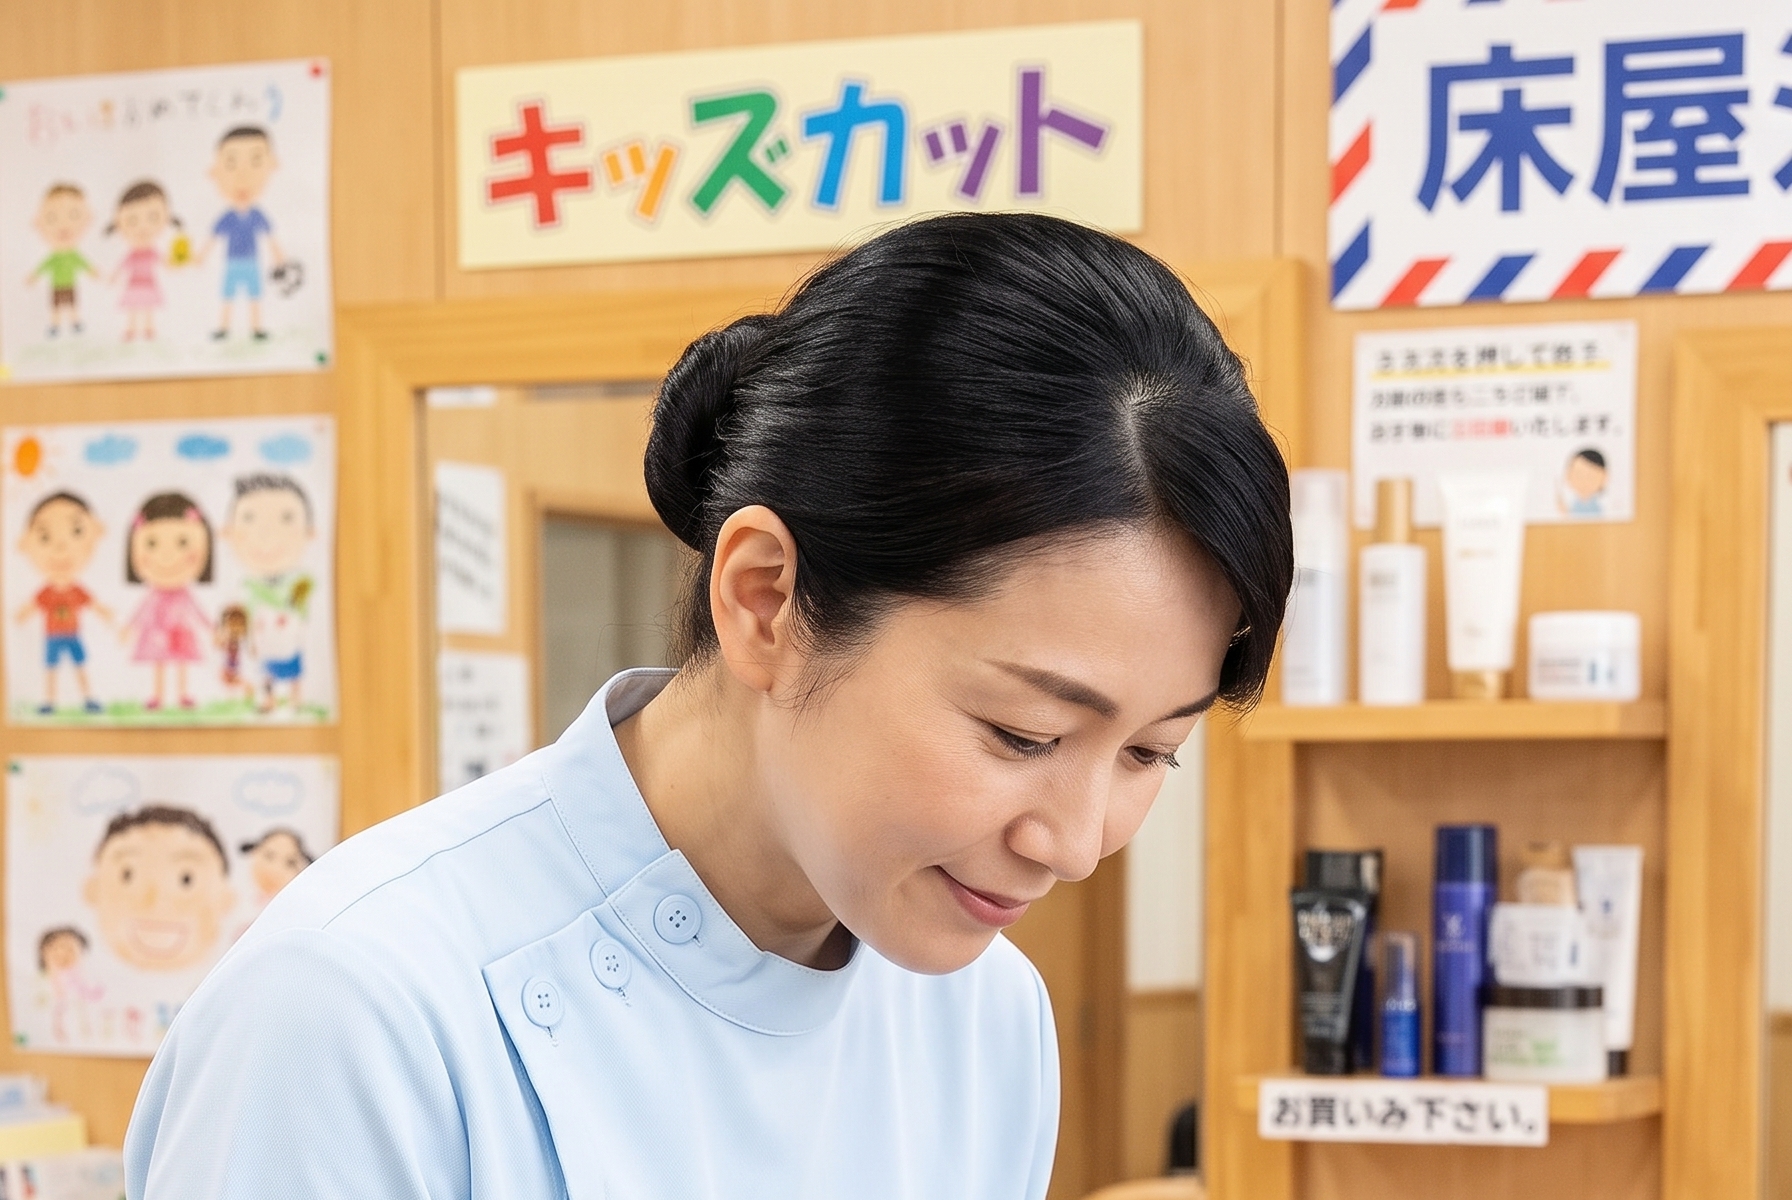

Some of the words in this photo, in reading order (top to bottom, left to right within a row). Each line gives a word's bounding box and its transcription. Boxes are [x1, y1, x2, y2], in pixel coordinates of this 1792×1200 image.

[488, 66, 1108, 226] キッズカット
[1417, 31, 1792, 213] 床屋
